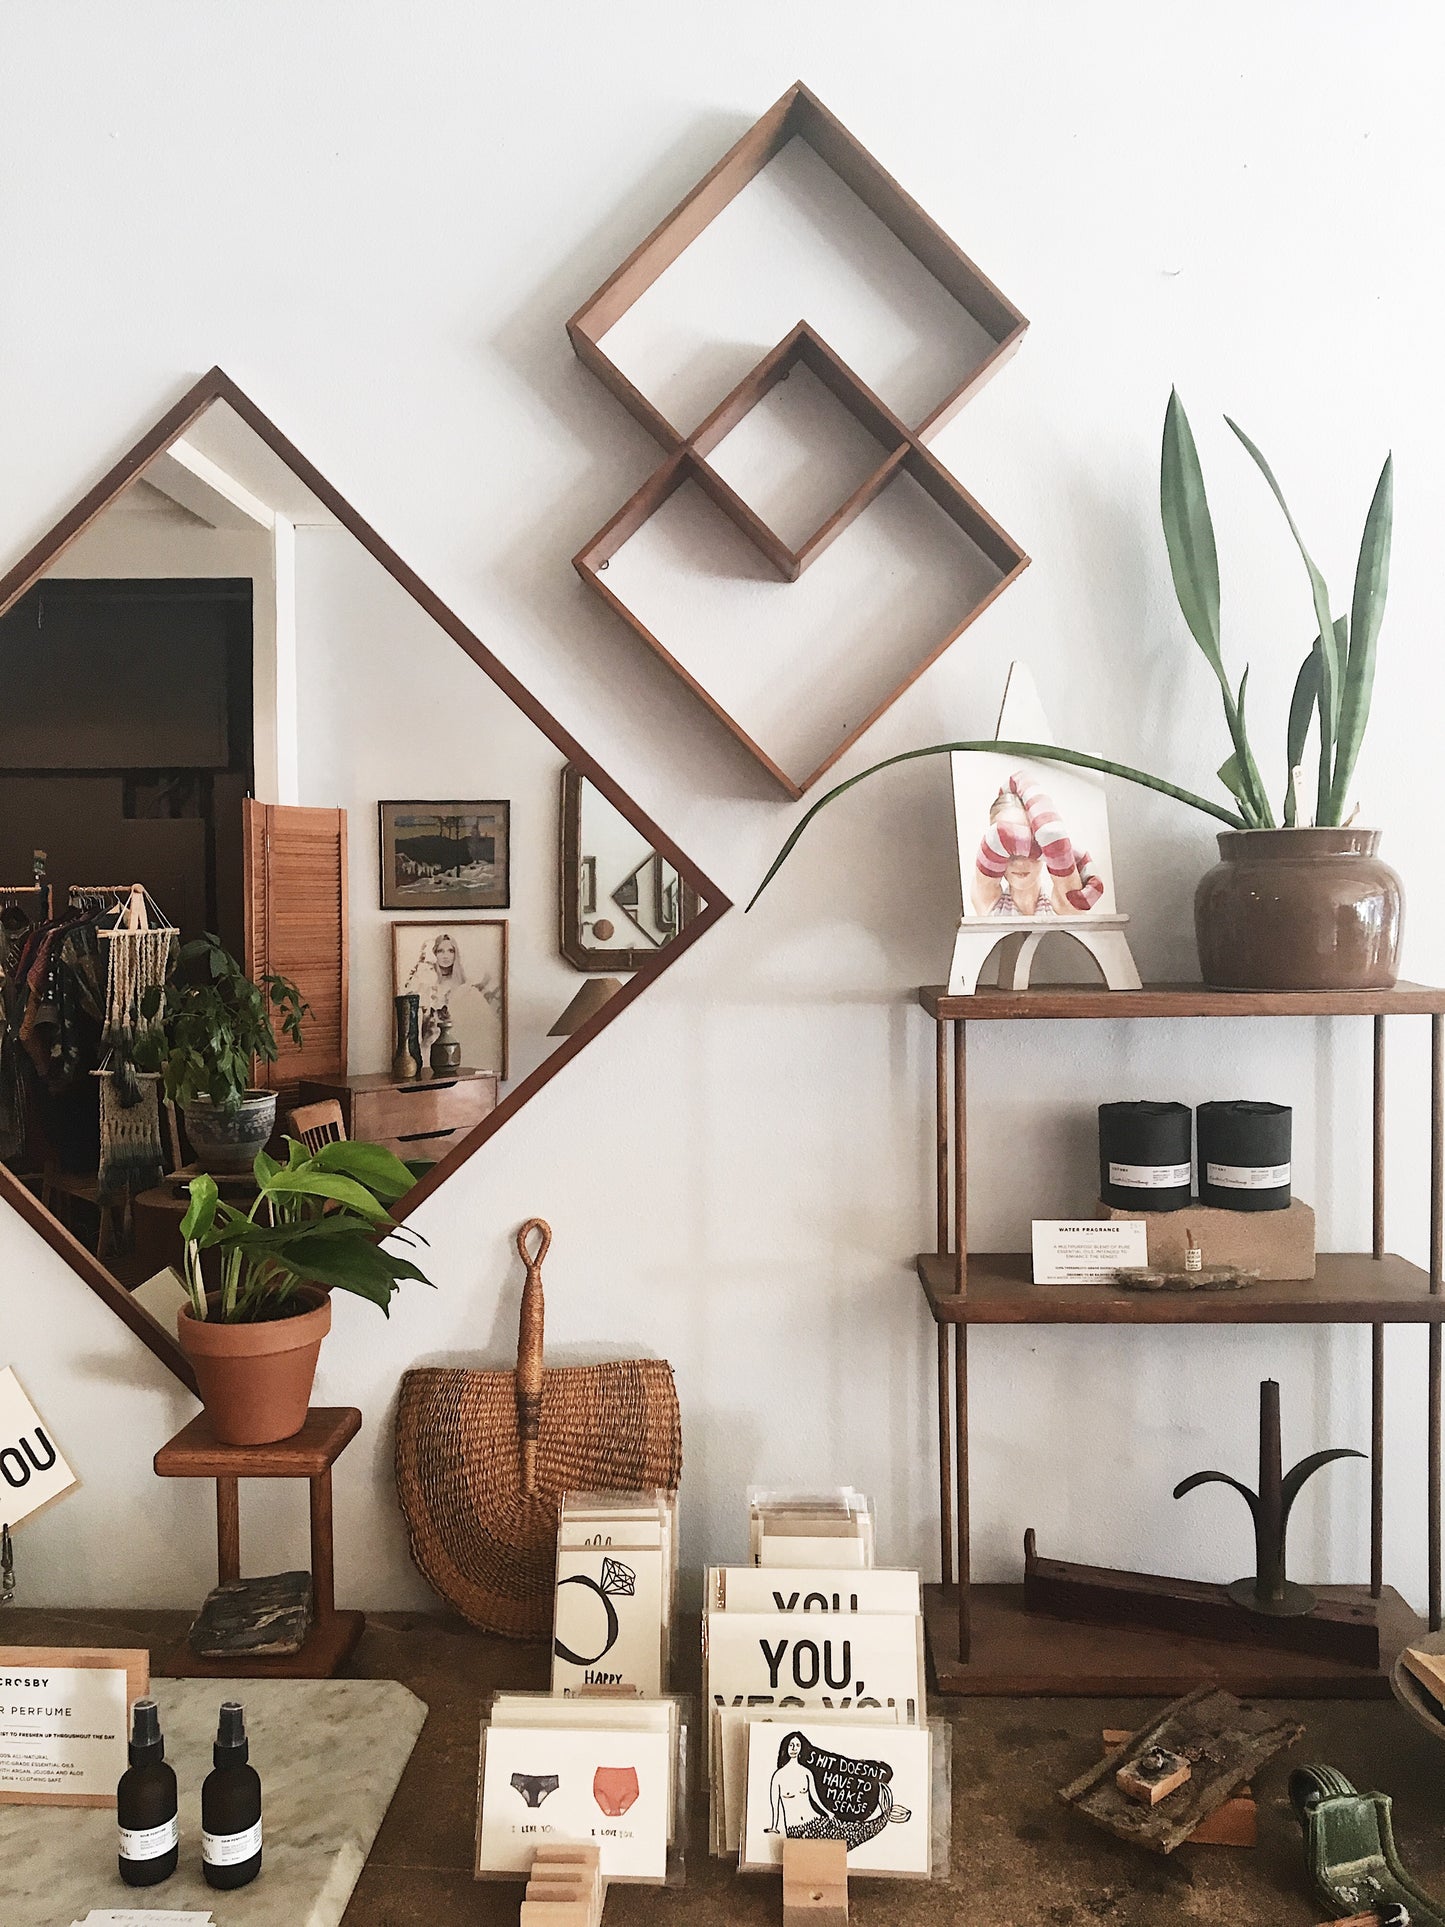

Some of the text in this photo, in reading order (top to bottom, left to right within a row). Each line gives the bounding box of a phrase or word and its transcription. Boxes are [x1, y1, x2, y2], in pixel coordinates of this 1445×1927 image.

[759, 1639, 865, 1697] YOU,
[584, 1669, 623, 1685] HAPPY
[11, 1706, 72, 1717] PERFUME
[807, 1751, 887, 1780] SHIT DOESN'T
[822, 1771, 872, 1792] HAVE TO
[826, 1787, 864, 1803] MAKE
[832, 1800, 868, 1815] SENSE
[521, 1825, 537, 1833] LIKE
[600, 1829, 617, 1837] LOVE
